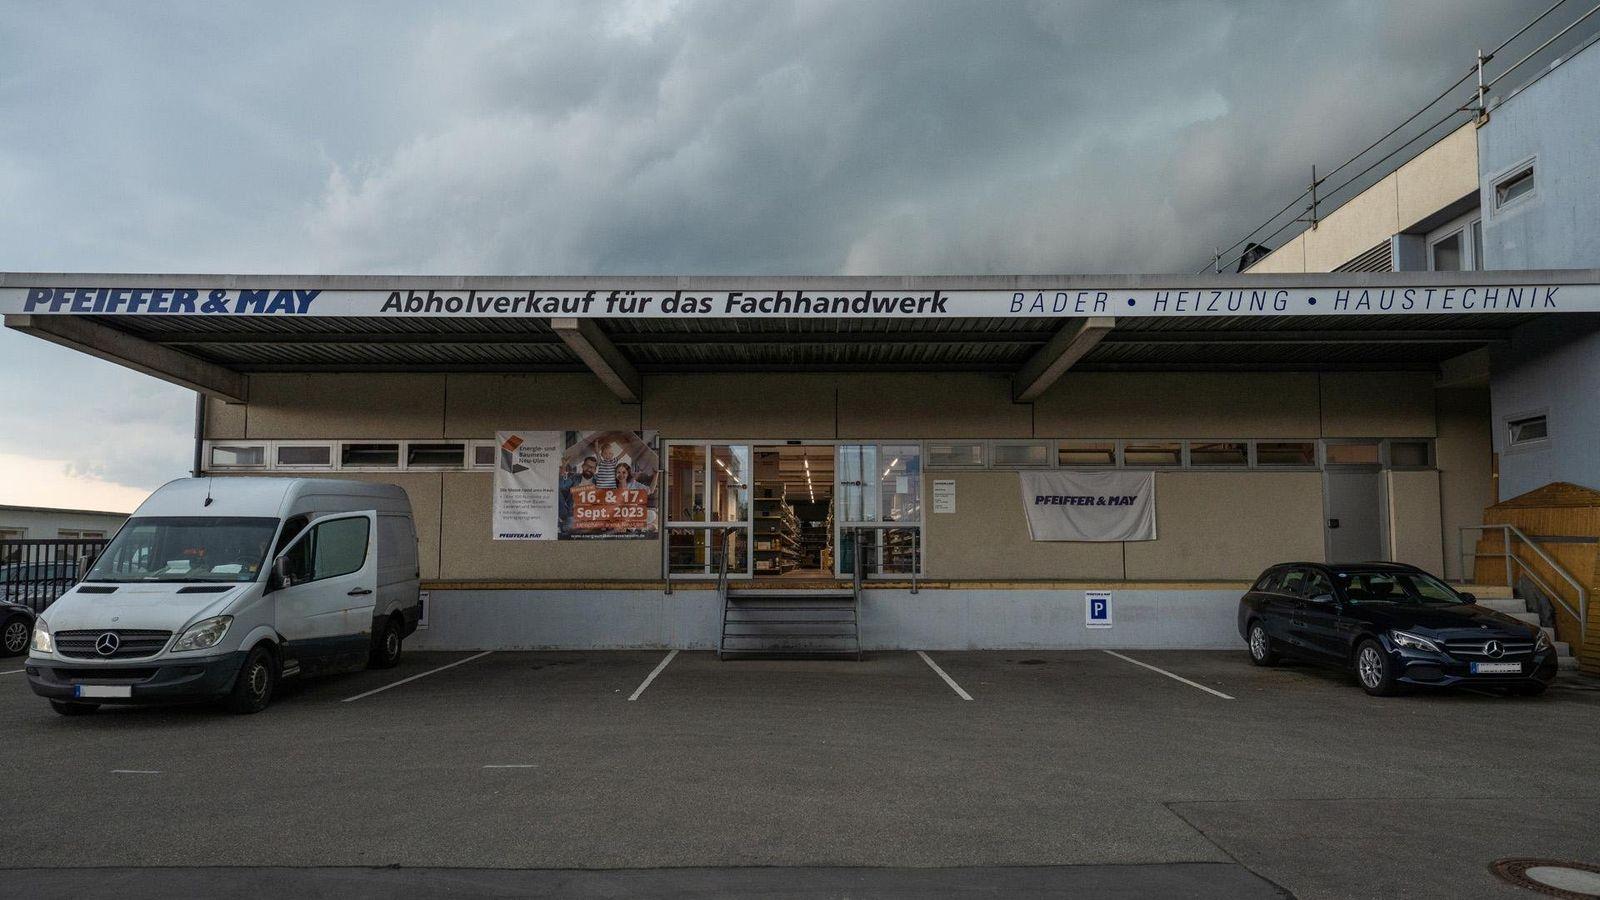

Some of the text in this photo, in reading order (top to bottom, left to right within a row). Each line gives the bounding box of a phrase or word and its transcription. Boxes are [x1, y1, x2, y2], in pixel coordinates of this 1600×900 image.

[23, 288, 199, 313] PFEIFFER
[234, 289, 322, 314] MAY
[380, 290, 949, 314] Abholverkauf für das Fachhandwerk
[1009, 287, 1560, 313] BÄDER HEIZUNG HAUSTECHNIK
[579, 490, 643, 503] 16. & 17.
[1035, 496, 1137, 506] PFEIFFER & MAY
[577, 507, 644, 520] Sept. 2023
[1094, 602, 1103, 616] P
